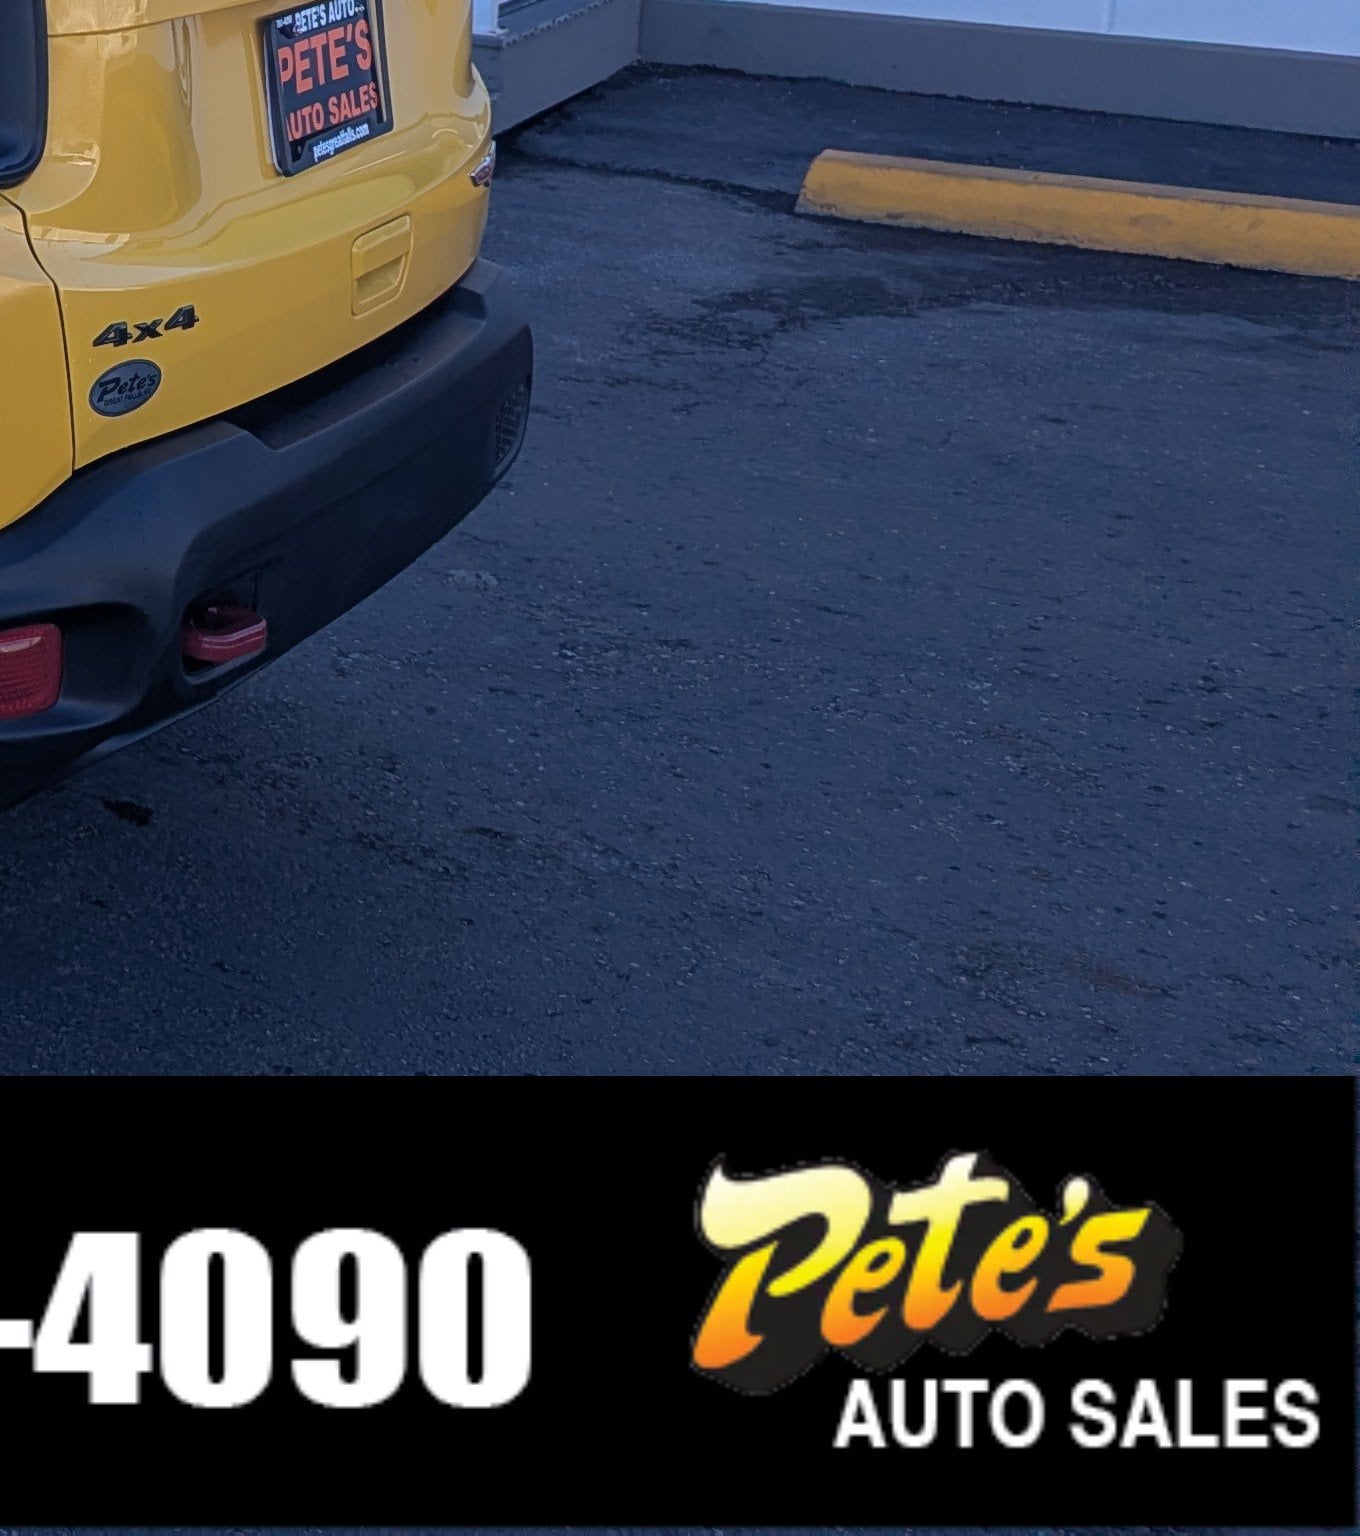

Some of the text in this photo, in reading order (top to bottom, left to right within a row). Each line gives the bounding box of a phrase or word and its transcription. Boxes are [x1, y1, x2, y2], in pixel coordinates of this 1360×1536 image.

[294, 4, 327, 34] PETE'S
[278, 19, 372, 94] PETE'S
[328, 81, 379, 126] SALES
[93, 304, 200, 348] 4x4
[97, 372, 158, 403] Pete's
